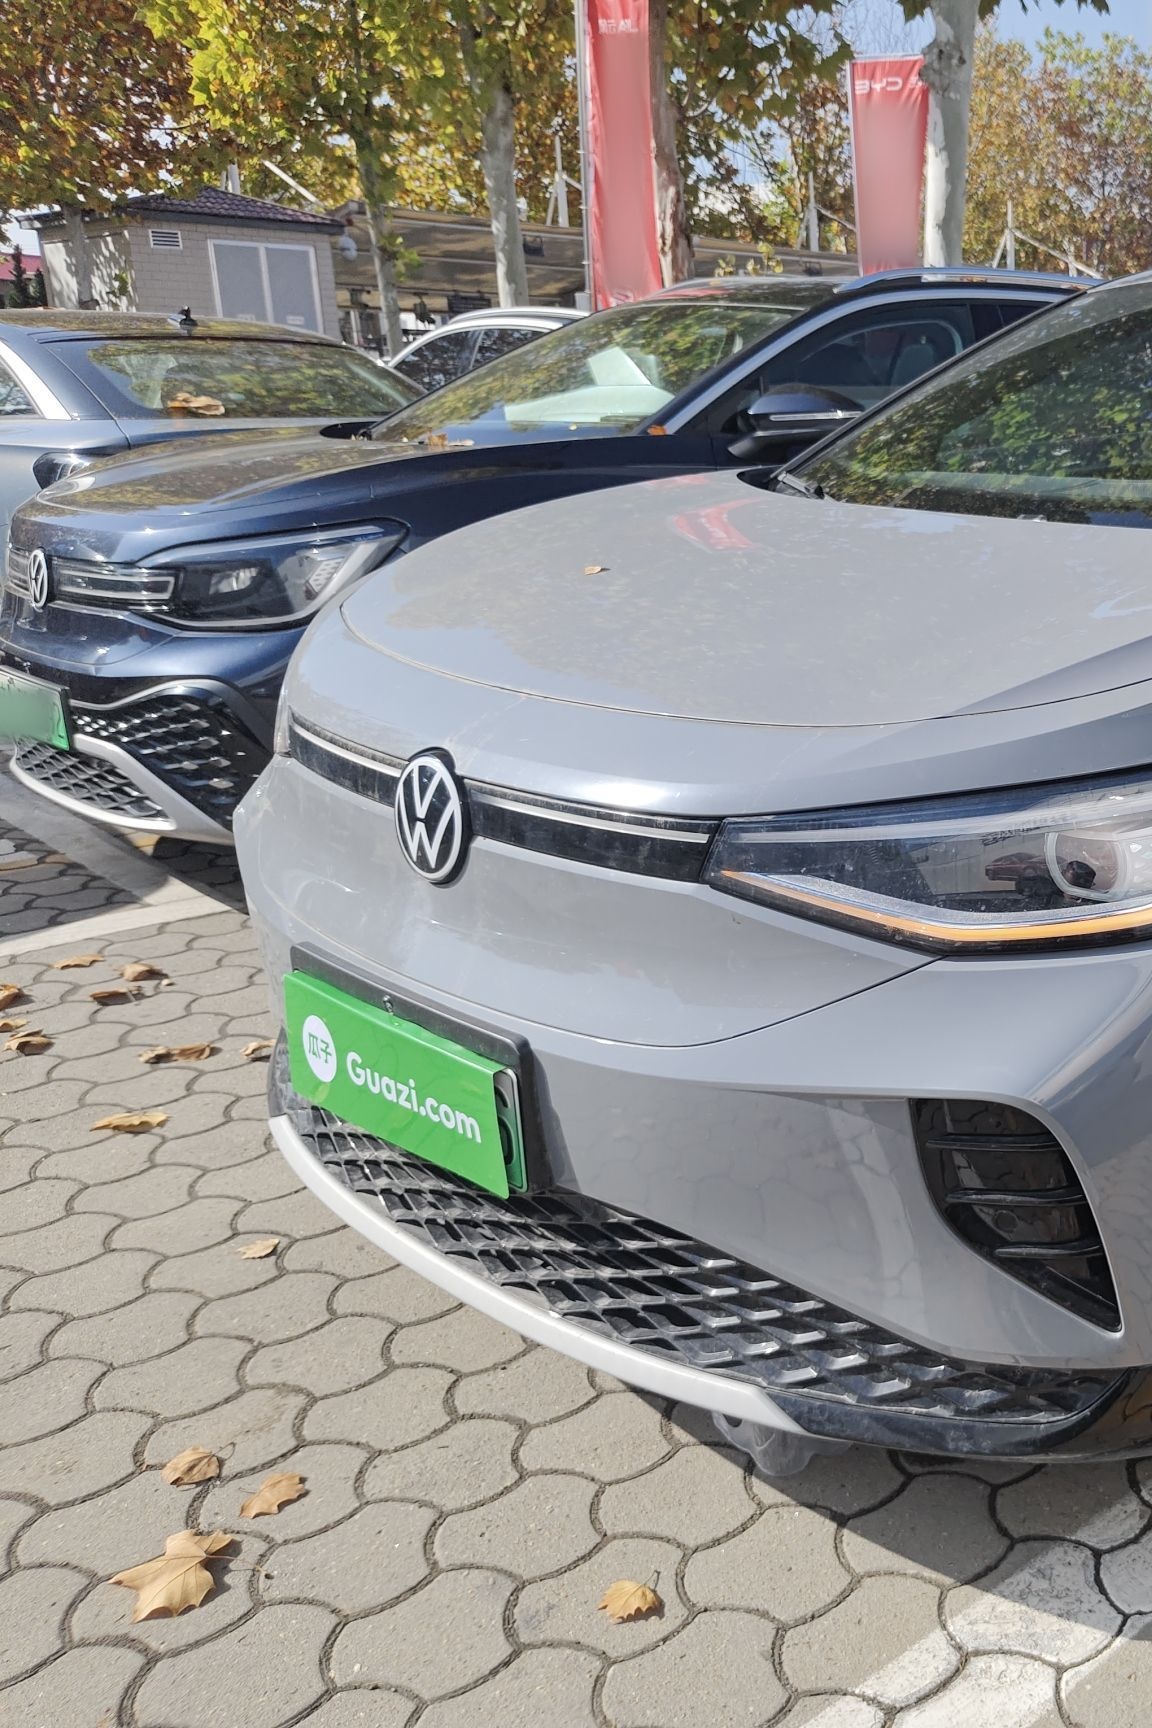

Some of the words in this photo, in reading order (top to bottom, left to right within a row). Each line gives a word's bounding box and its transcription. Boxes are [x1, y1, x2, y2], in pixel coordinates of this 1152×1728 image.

[855, 76, 903, 95] BYD
[394, 755, 463, 883] VW
[308, 1032, 333, 1065] 瓜子
[346, 1051, 482, 1144] Guazi.com
